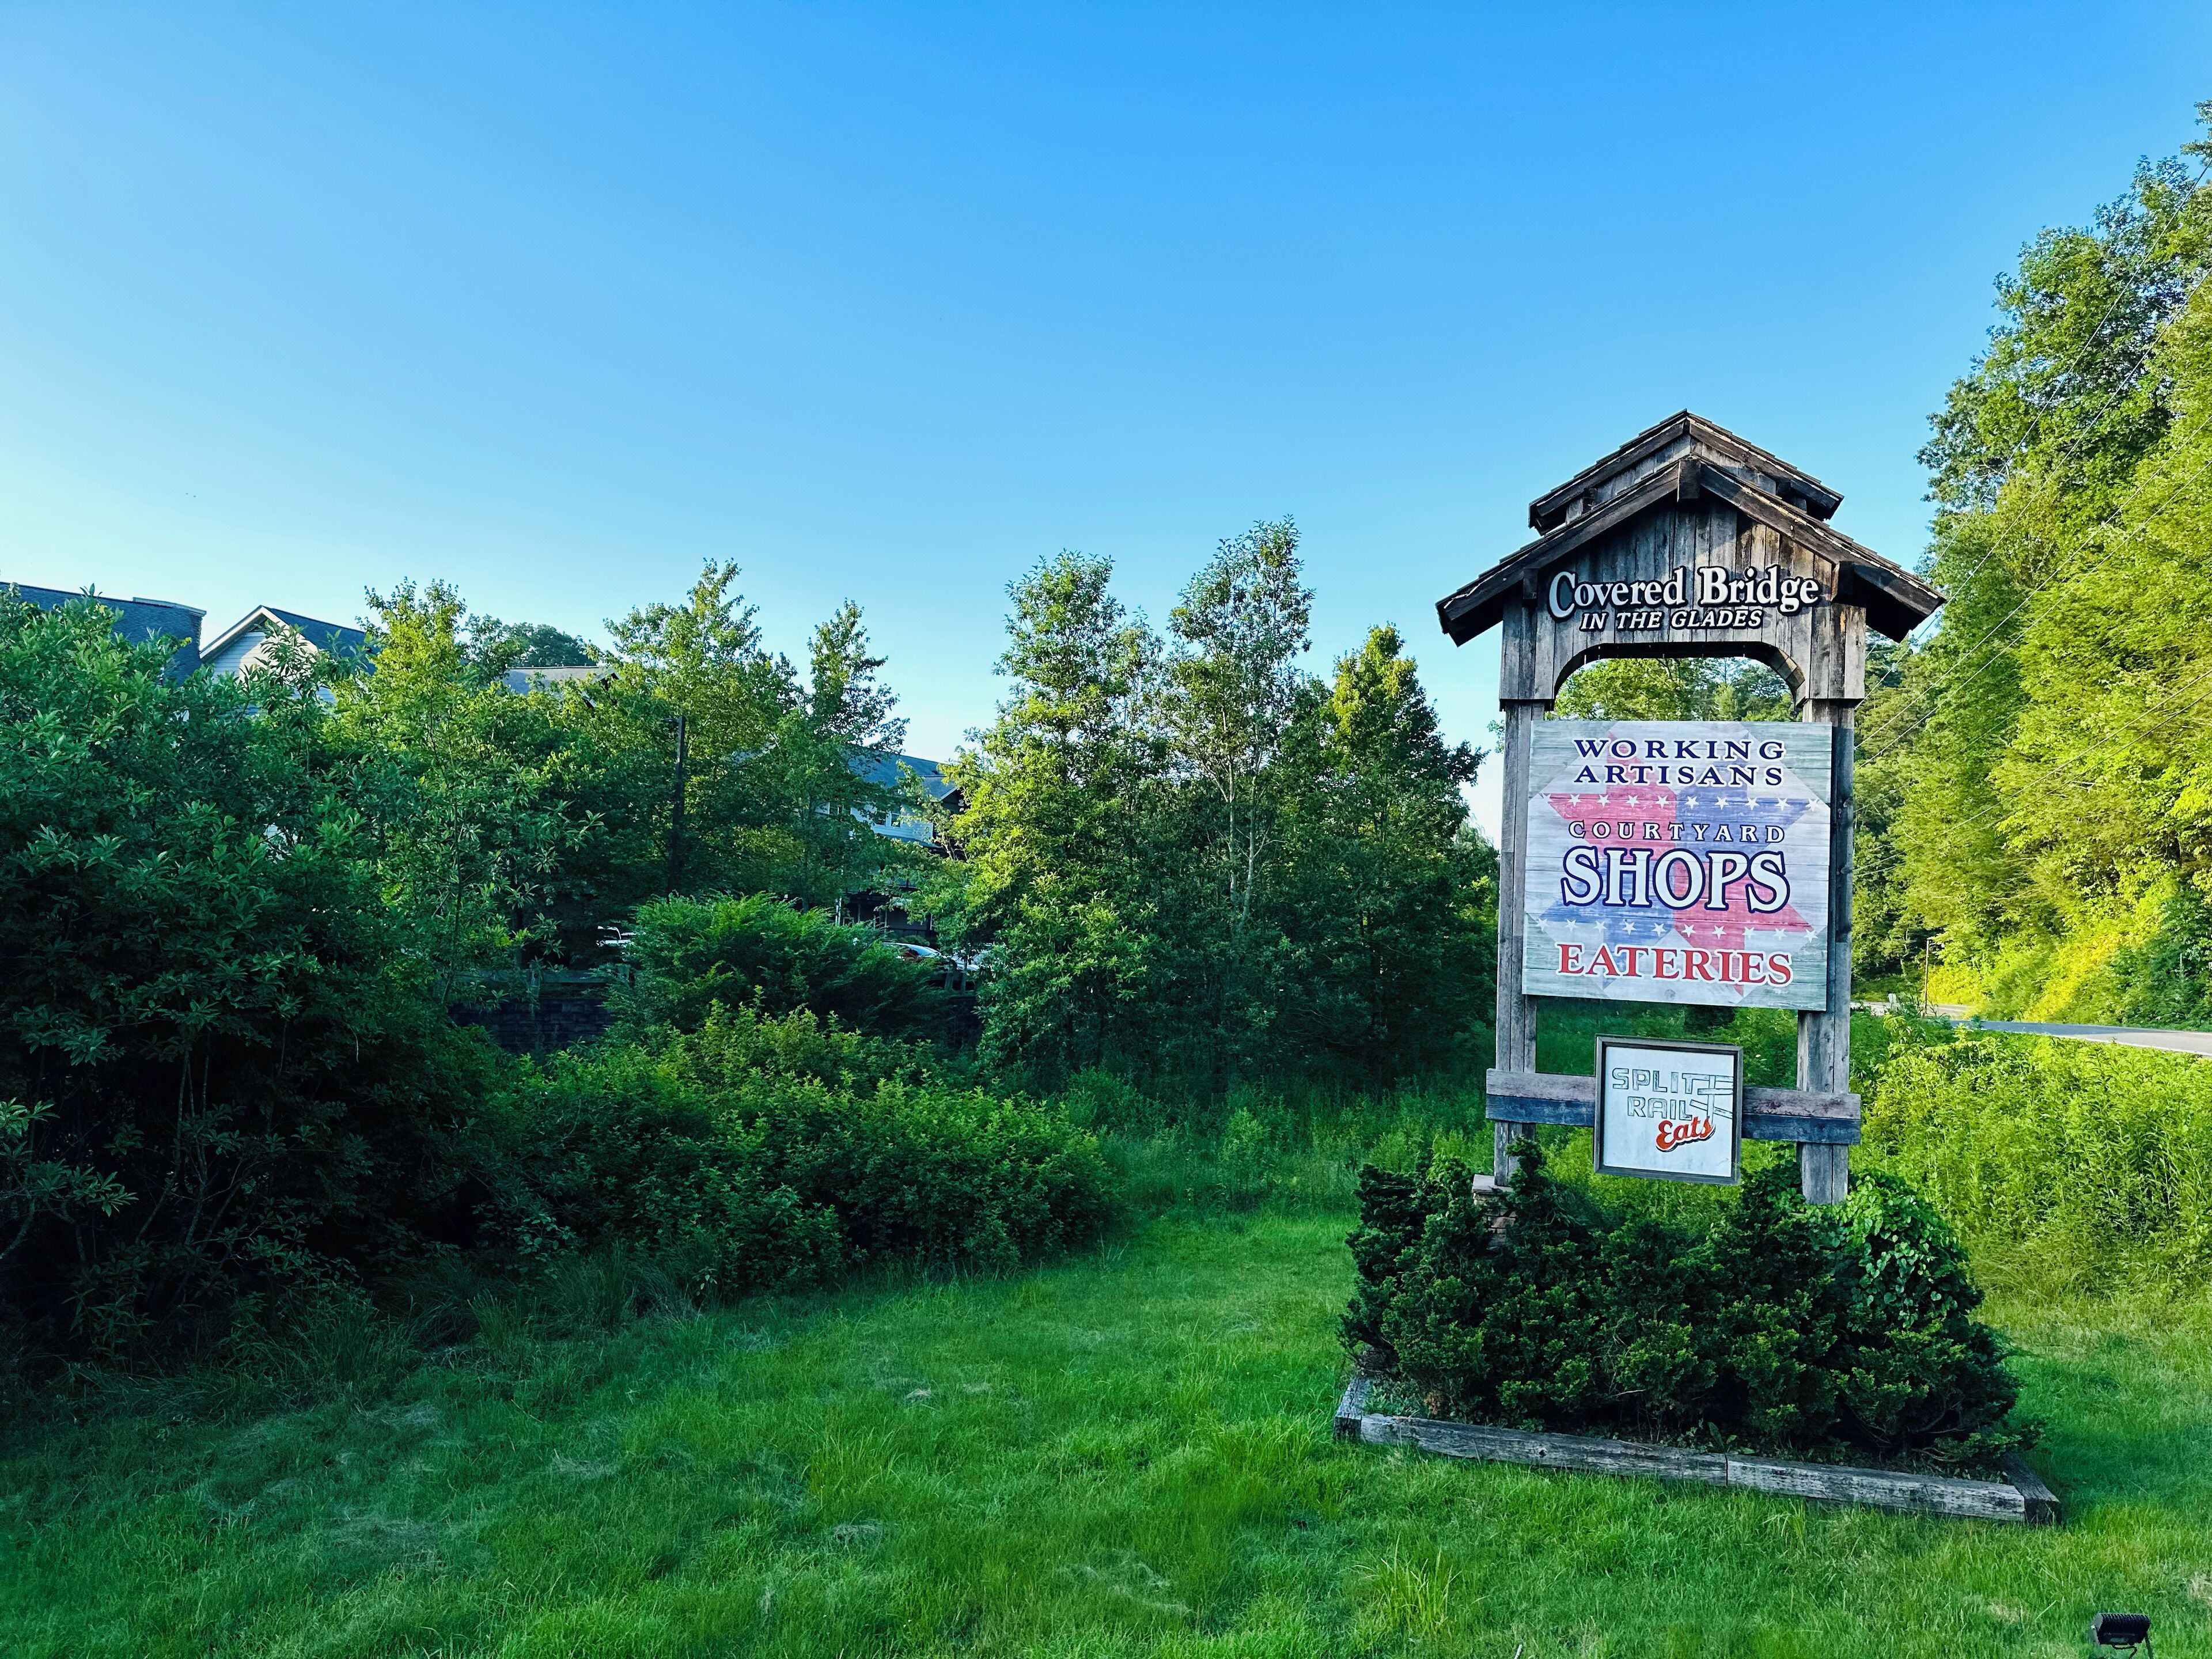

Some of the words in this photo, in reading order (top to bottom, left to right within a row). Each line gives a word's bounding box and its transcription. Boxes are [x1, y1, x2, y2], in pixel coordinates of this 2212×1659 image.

[1548, 567, 1685, 618] Covered
[1699, 565, 1819, 612] Bridge
[1581, 611, 1608, 630] IN
[1616, 611, 1661, 628] THE
[1671, 609, 1762, 628] GLADES
[1573, 739, 1785, 760] WORKING
[1574, 765, 1783, 786] ARTISANS
[1568, 820, 1785, 843] COURTYARD
[1561, 846, 1790, 913] SHOPS
[1556, 943, 1791, 984] EATERIES
[1612, 1068, 1707, 1094] SPLIT
[1627, 1096, 1692, 1120] RAIL
[1656, 1116, 1714, 1150] Eats
